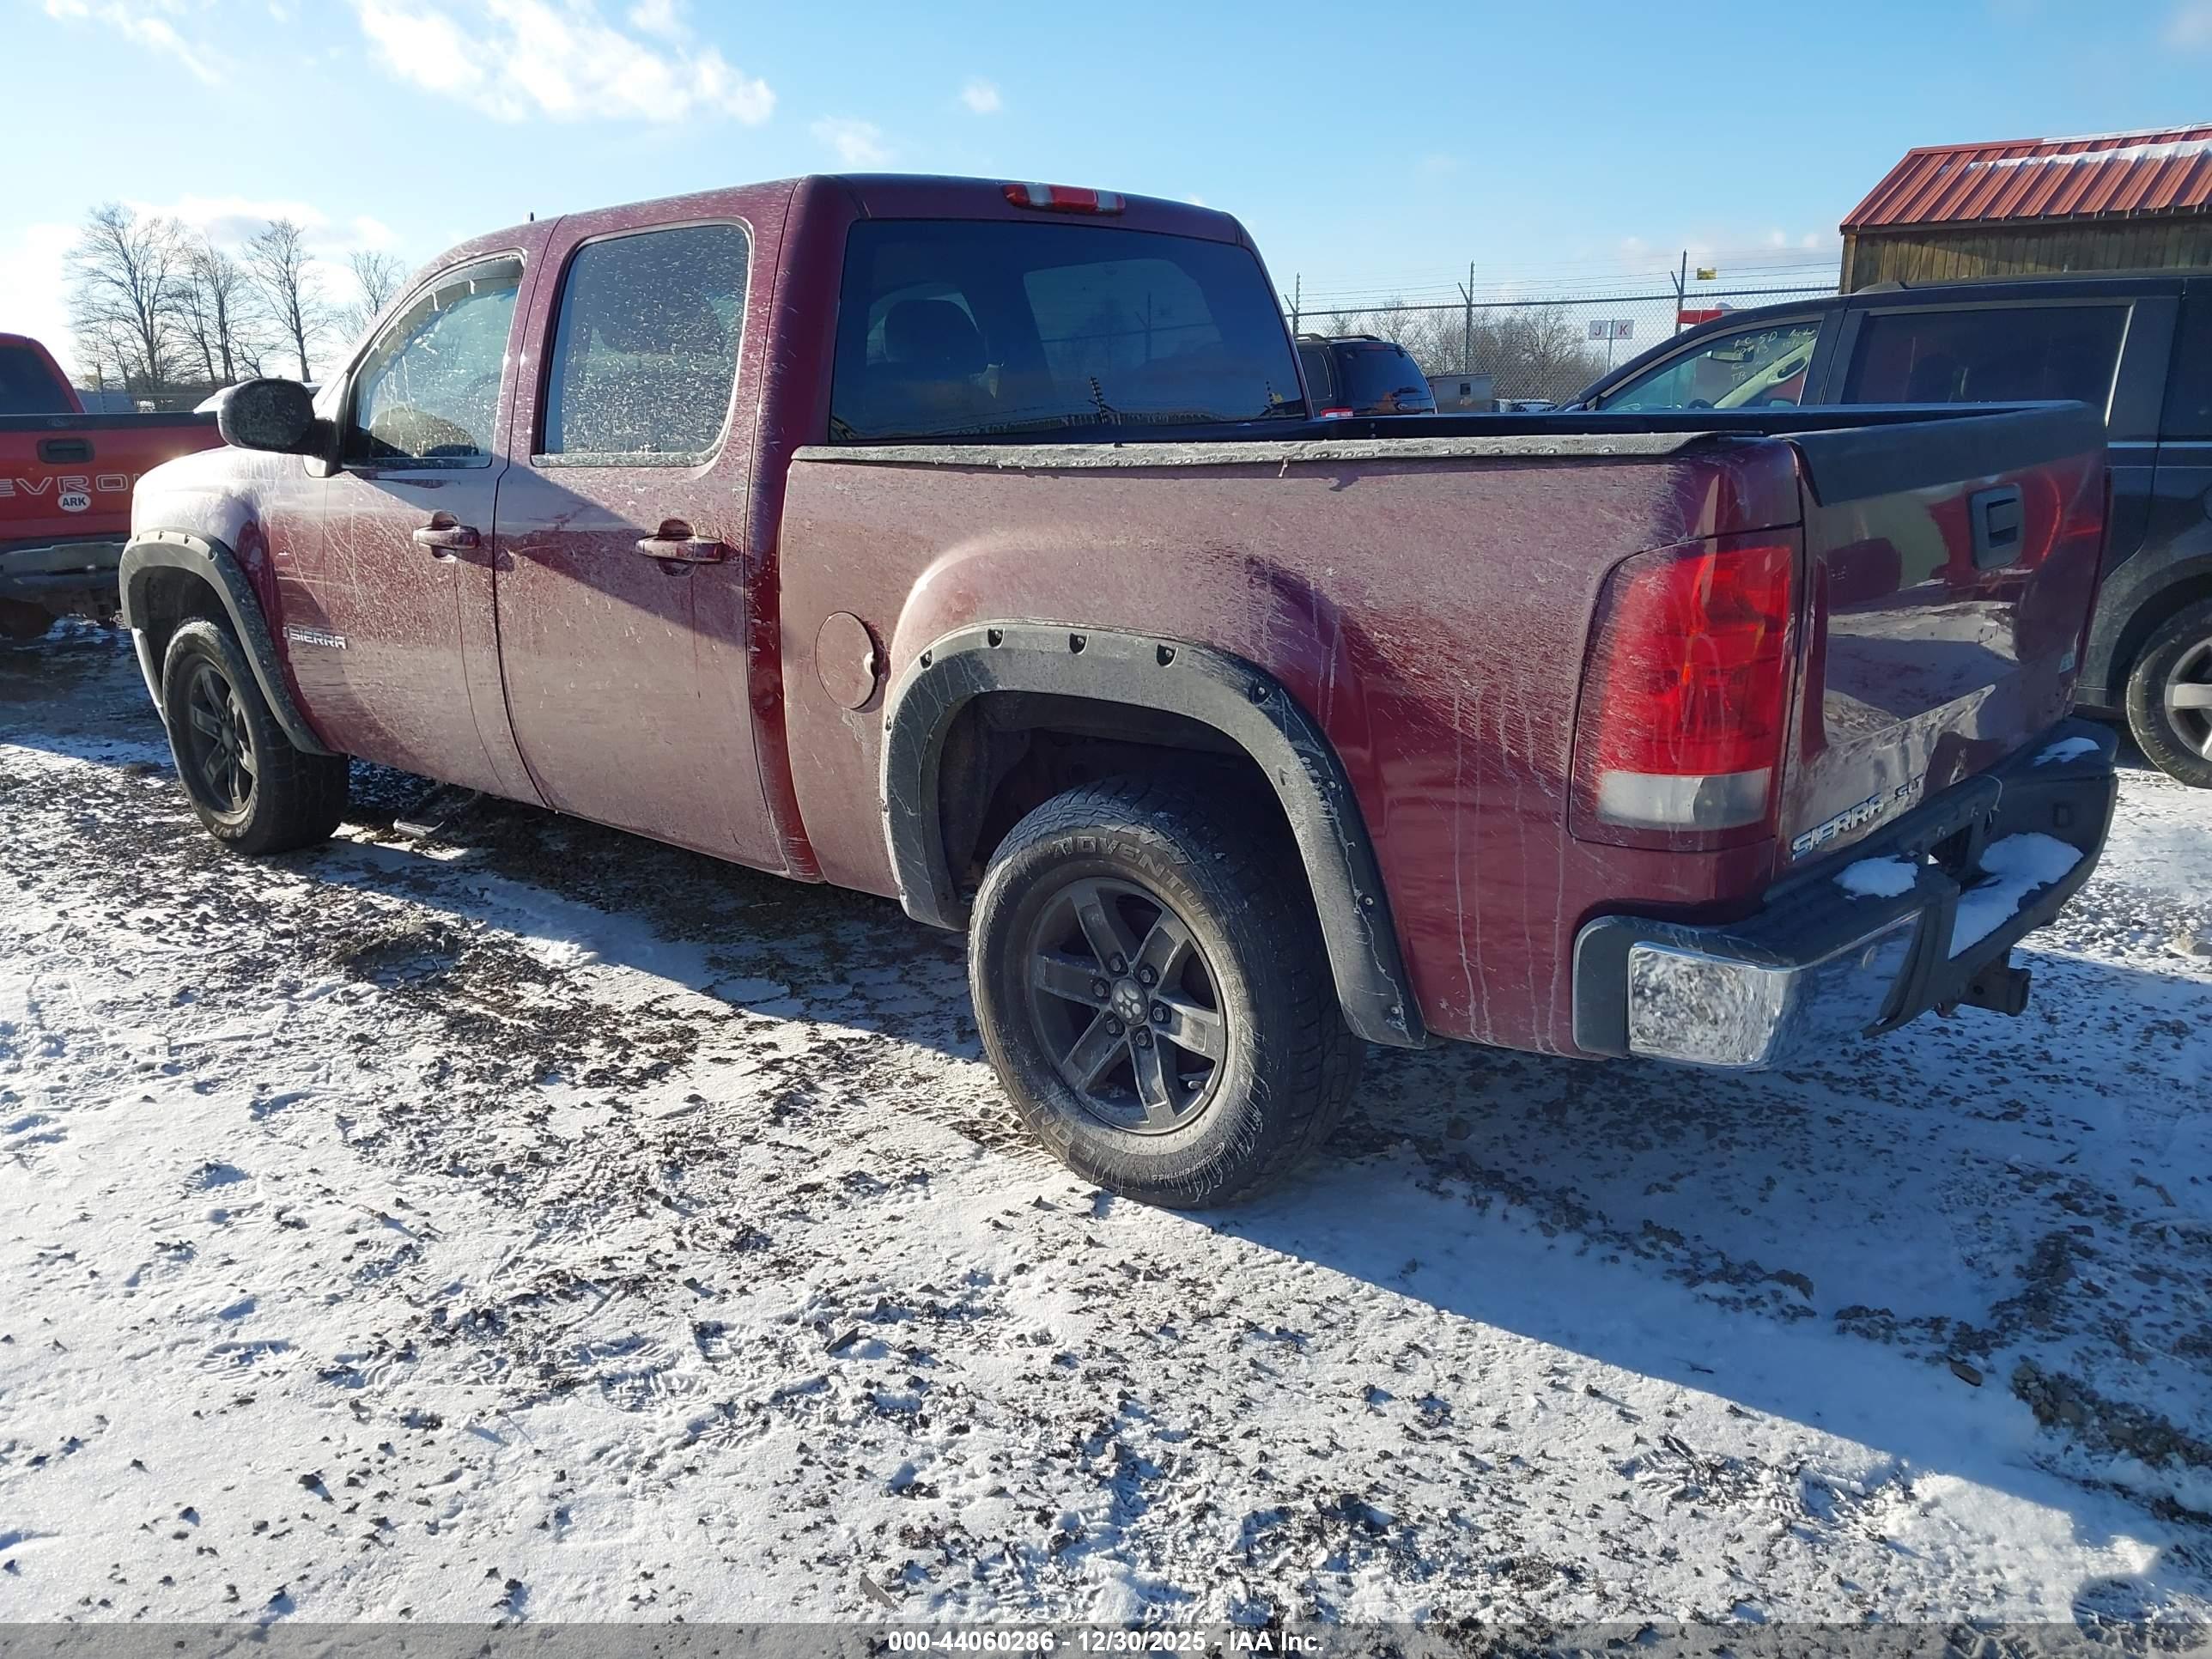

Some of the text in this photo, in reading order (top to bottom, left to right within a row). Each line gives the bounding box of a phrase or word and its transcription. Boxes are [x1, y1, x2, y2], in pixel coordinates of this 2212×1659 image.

[1594, 325, 1603, 337] J
[1619, 324, 1629, 336] K
[62, 497, 87, 507] ARK
[289, 628, 349, 650] SIERRA
[1791, 773, 1926, 861] SIERRA SLT
